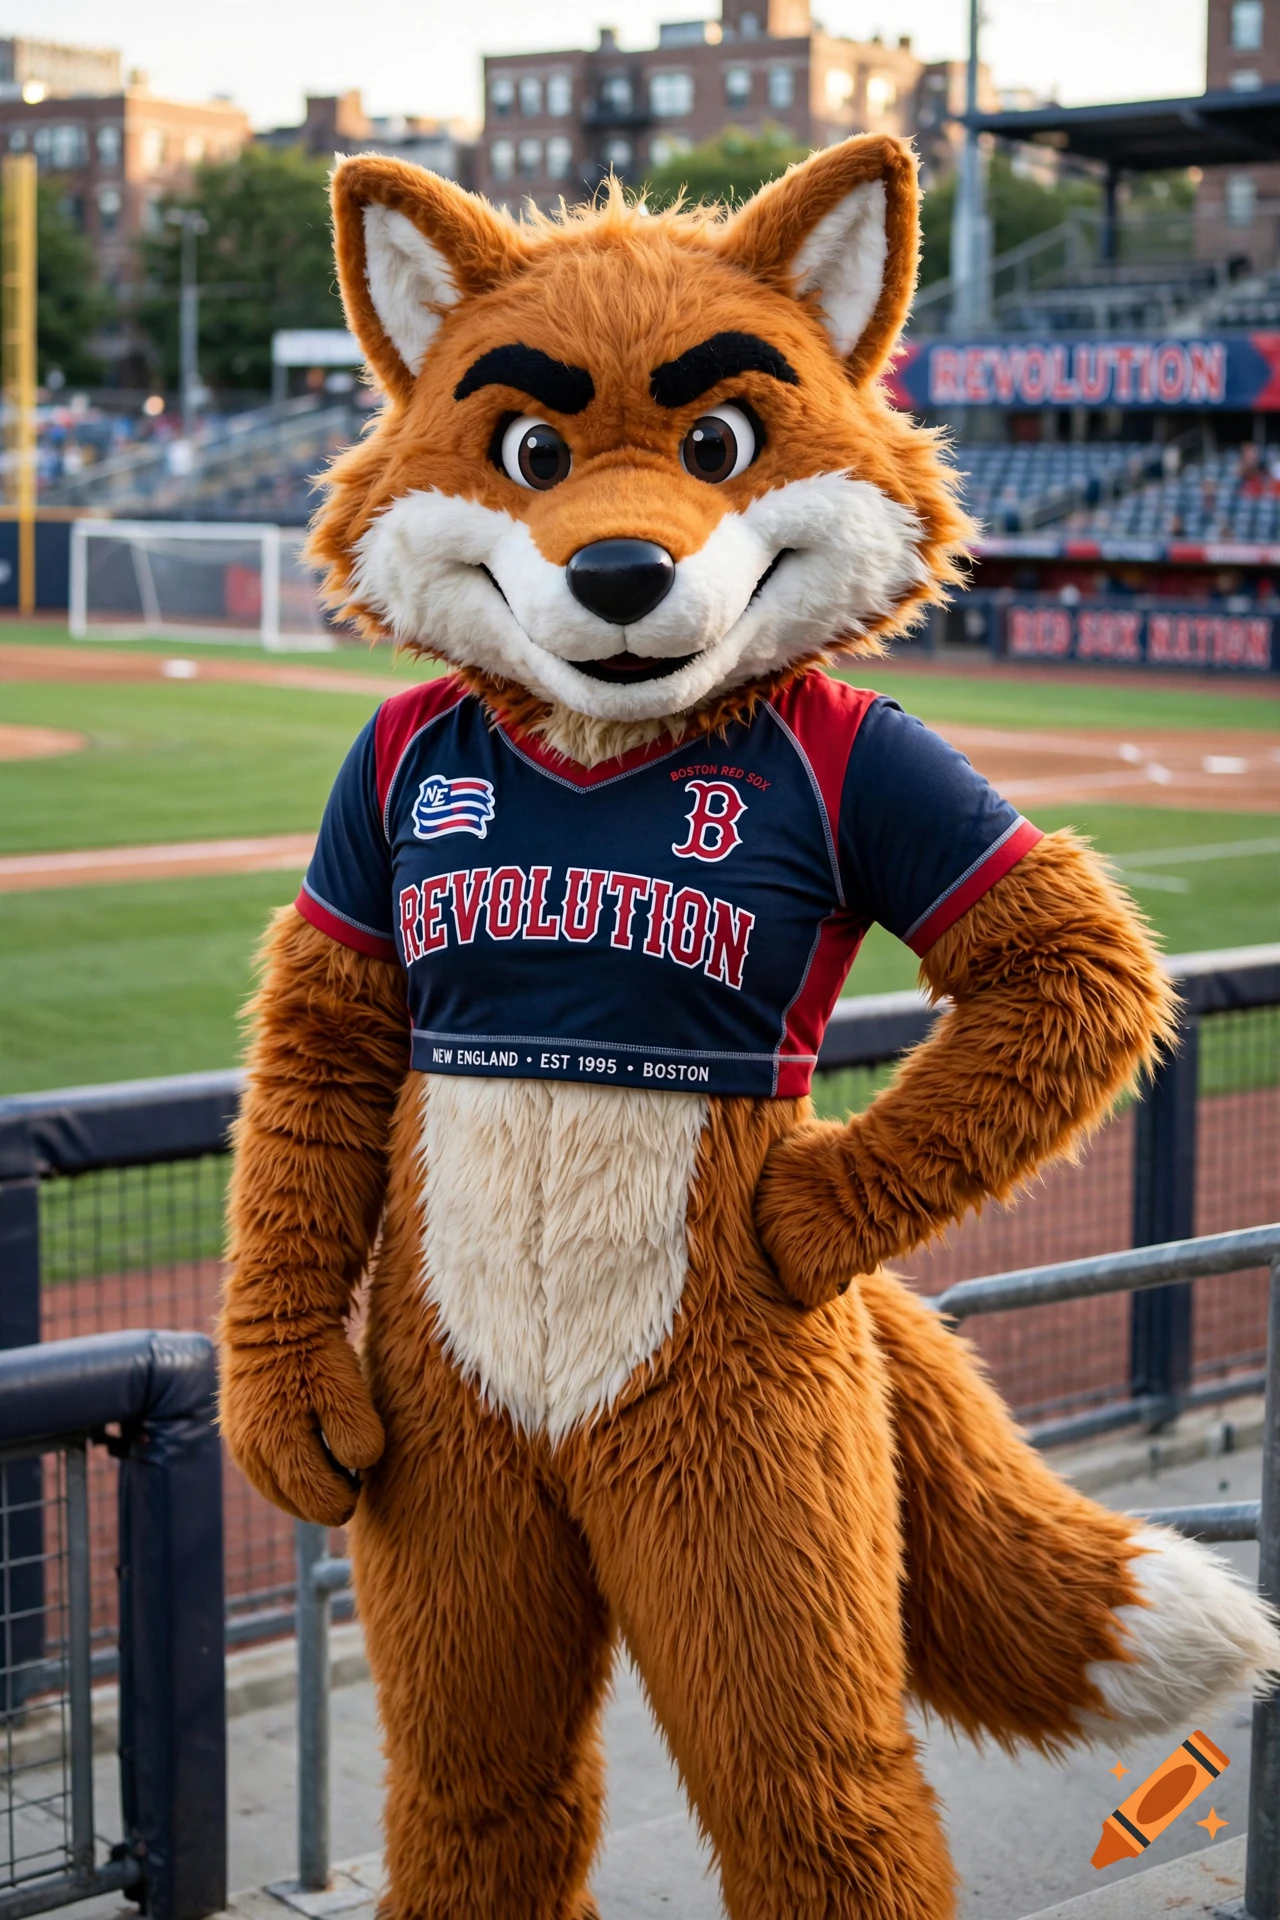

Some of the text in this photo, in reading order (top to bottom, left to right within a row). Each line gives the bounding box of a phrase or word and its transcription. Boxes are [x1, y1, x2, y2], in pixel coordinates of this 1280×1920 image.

[930, 342, 1226, 403] REVOLUTION
[1009, 606, 1272, 669] RED SOX NATION
[422, 785, 449, 807] NE
[670, 765, 772, 792] BOSTON RED SOX
[671, 779, 749, 863] B
[399, 865, 756, 991] REVOLUTION
[432, 1047, 710, 1082] NEW ENGLAND EST 1995 BOSTON
